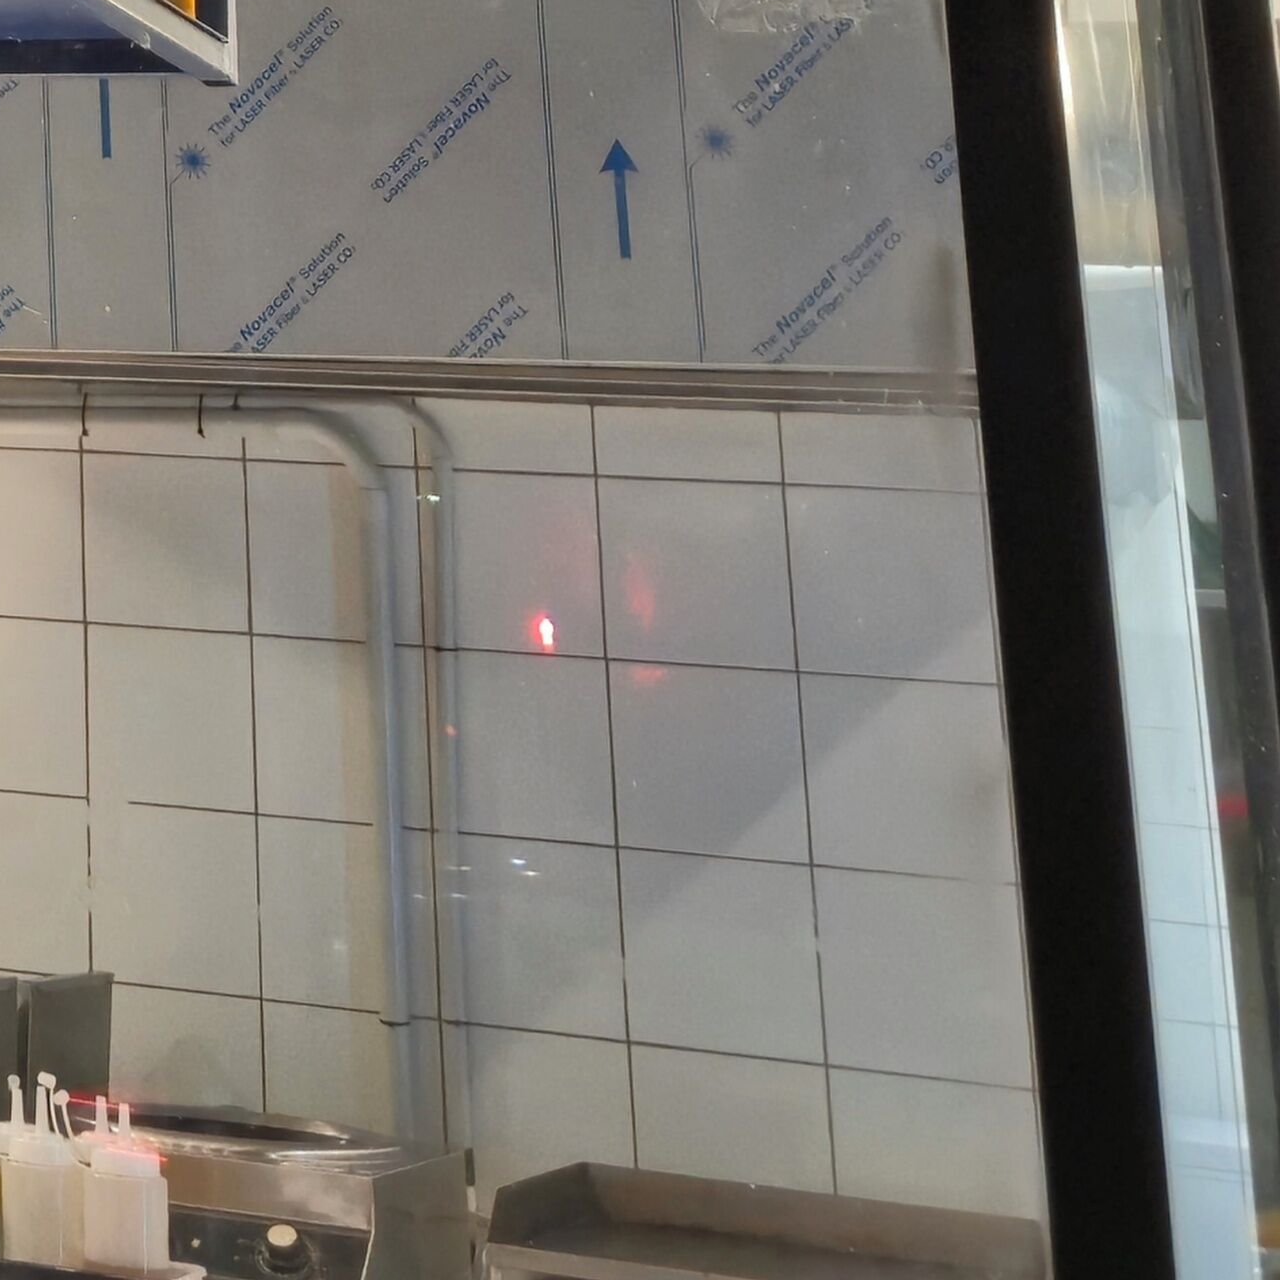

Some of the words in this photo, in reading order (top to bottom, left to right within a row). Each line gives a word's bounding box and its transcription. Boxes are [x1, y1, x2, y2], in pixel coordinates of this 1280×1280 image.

[208, 114, 232, 136] The
[287, 6, 333, 52] Solution
[234, 99, 267, 133] LASER
[293, 35, 327, 69] LASER
[488, 69, 512, 92] The
[449, 73, 484, 108] LASER
[388, 138, 423, 174] LASER
[383, 156, 430, 204] Solution
[298, 232, 346, 279] Solution
[305, 263, 340, 297] LASER
[466, 307, 500, 342] LASER
